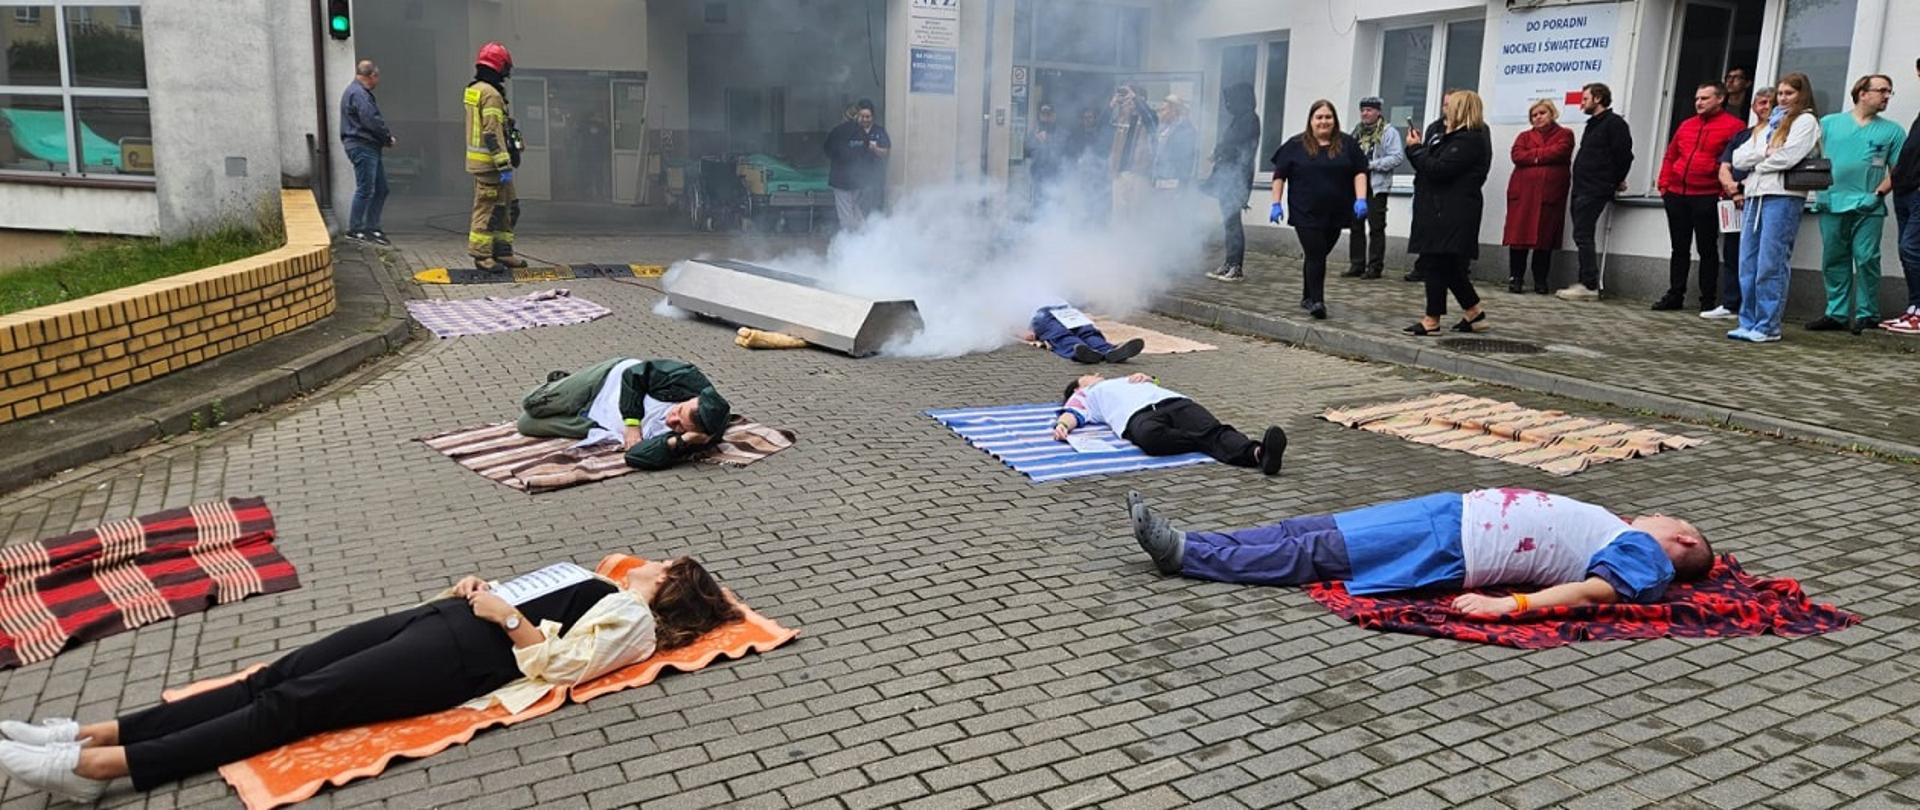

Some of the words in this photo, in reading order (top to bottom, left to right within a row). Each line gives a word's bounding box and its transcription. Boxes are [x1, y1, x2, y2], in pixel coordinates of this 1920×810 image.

[1526, 21, 1540, 32] DO
[1542, 17, 1587, 30] PORADNI
[1503, 42, 1536, 54] NOCNEJ
[1544, 37, 1609, 52] ŚWIĄTECZNEJ
[1504, 63, 1534, 75] OPIEKI
[1536, 59, 1602, 73] ZDROWOTNEJ
